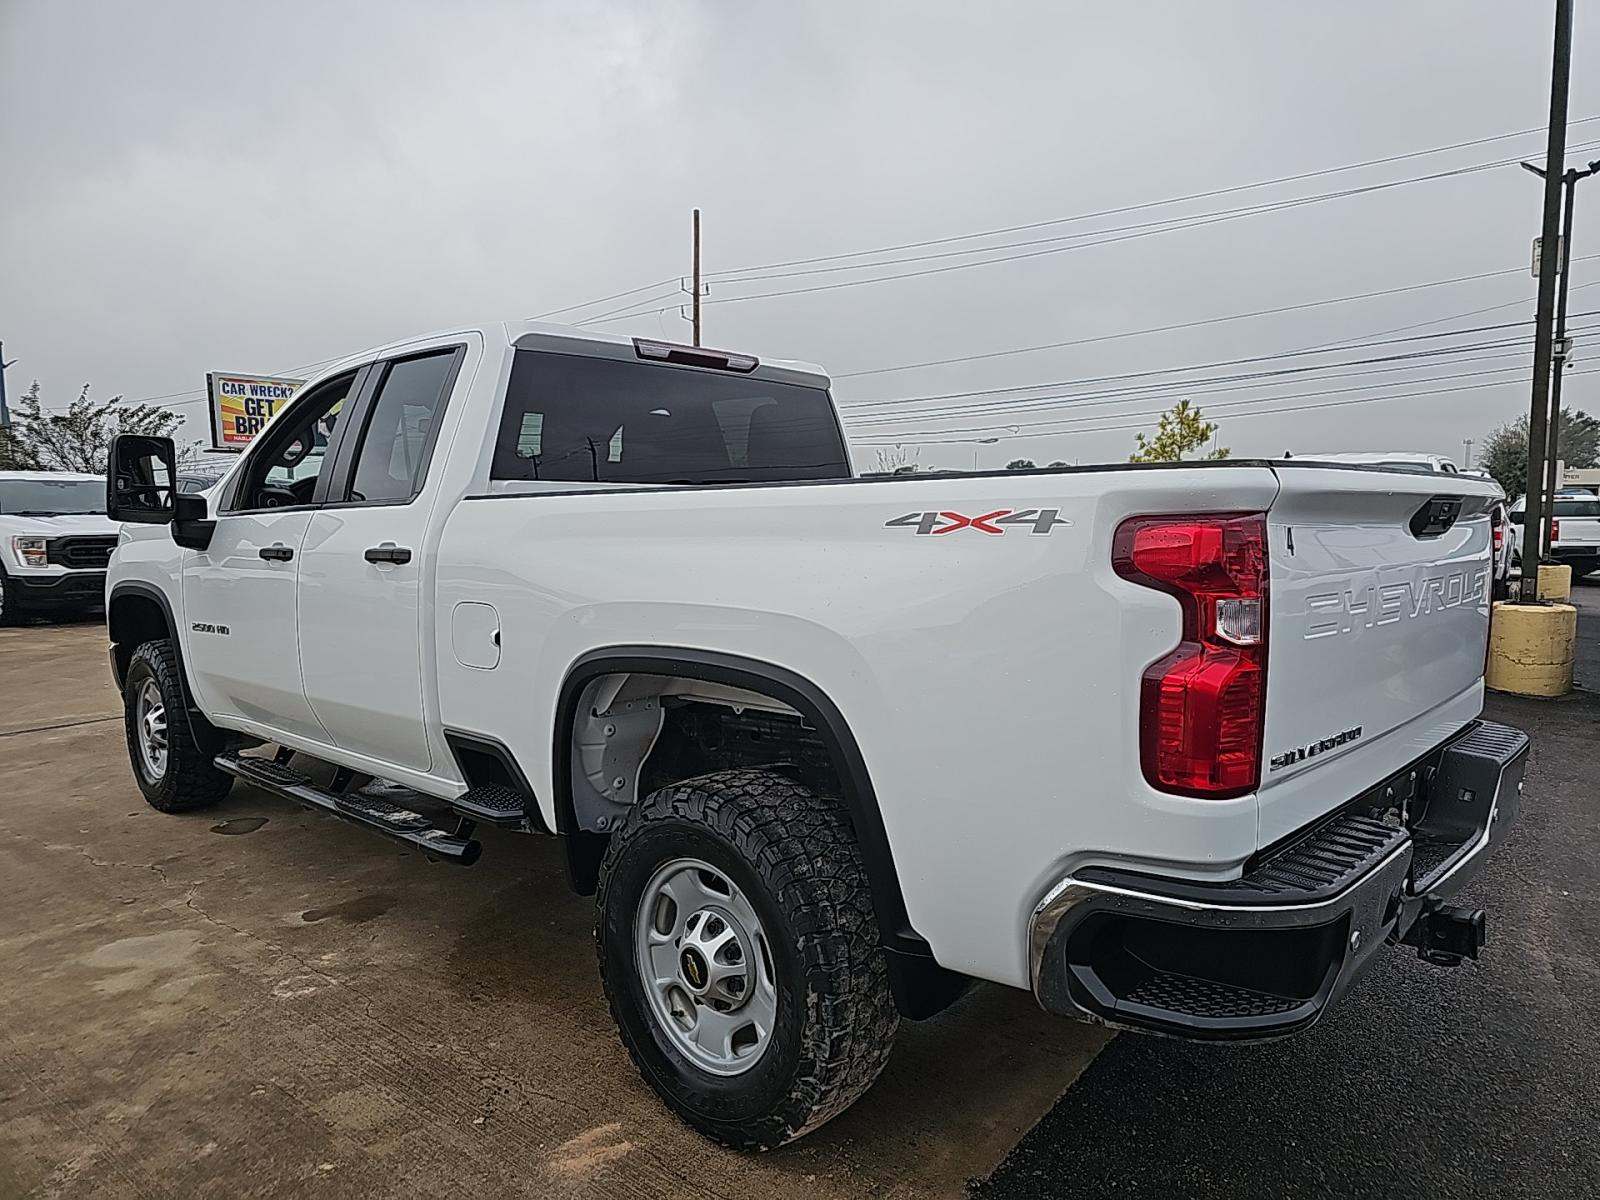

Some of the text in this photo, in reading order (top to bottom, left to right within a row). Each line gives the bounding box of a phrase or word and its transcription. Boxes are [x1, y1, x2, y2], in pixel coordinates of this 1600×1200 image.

[222, 382, 294, 398] CAR WRECK?
[244, 397, 275, 417] GET
[234, 415, 271, 435] BRI
[883, 508, 1072, 536] 4X4
[192, 622, 230, 635] 2500 HD
[1270, 724, 1363, 772] SILVERADO
